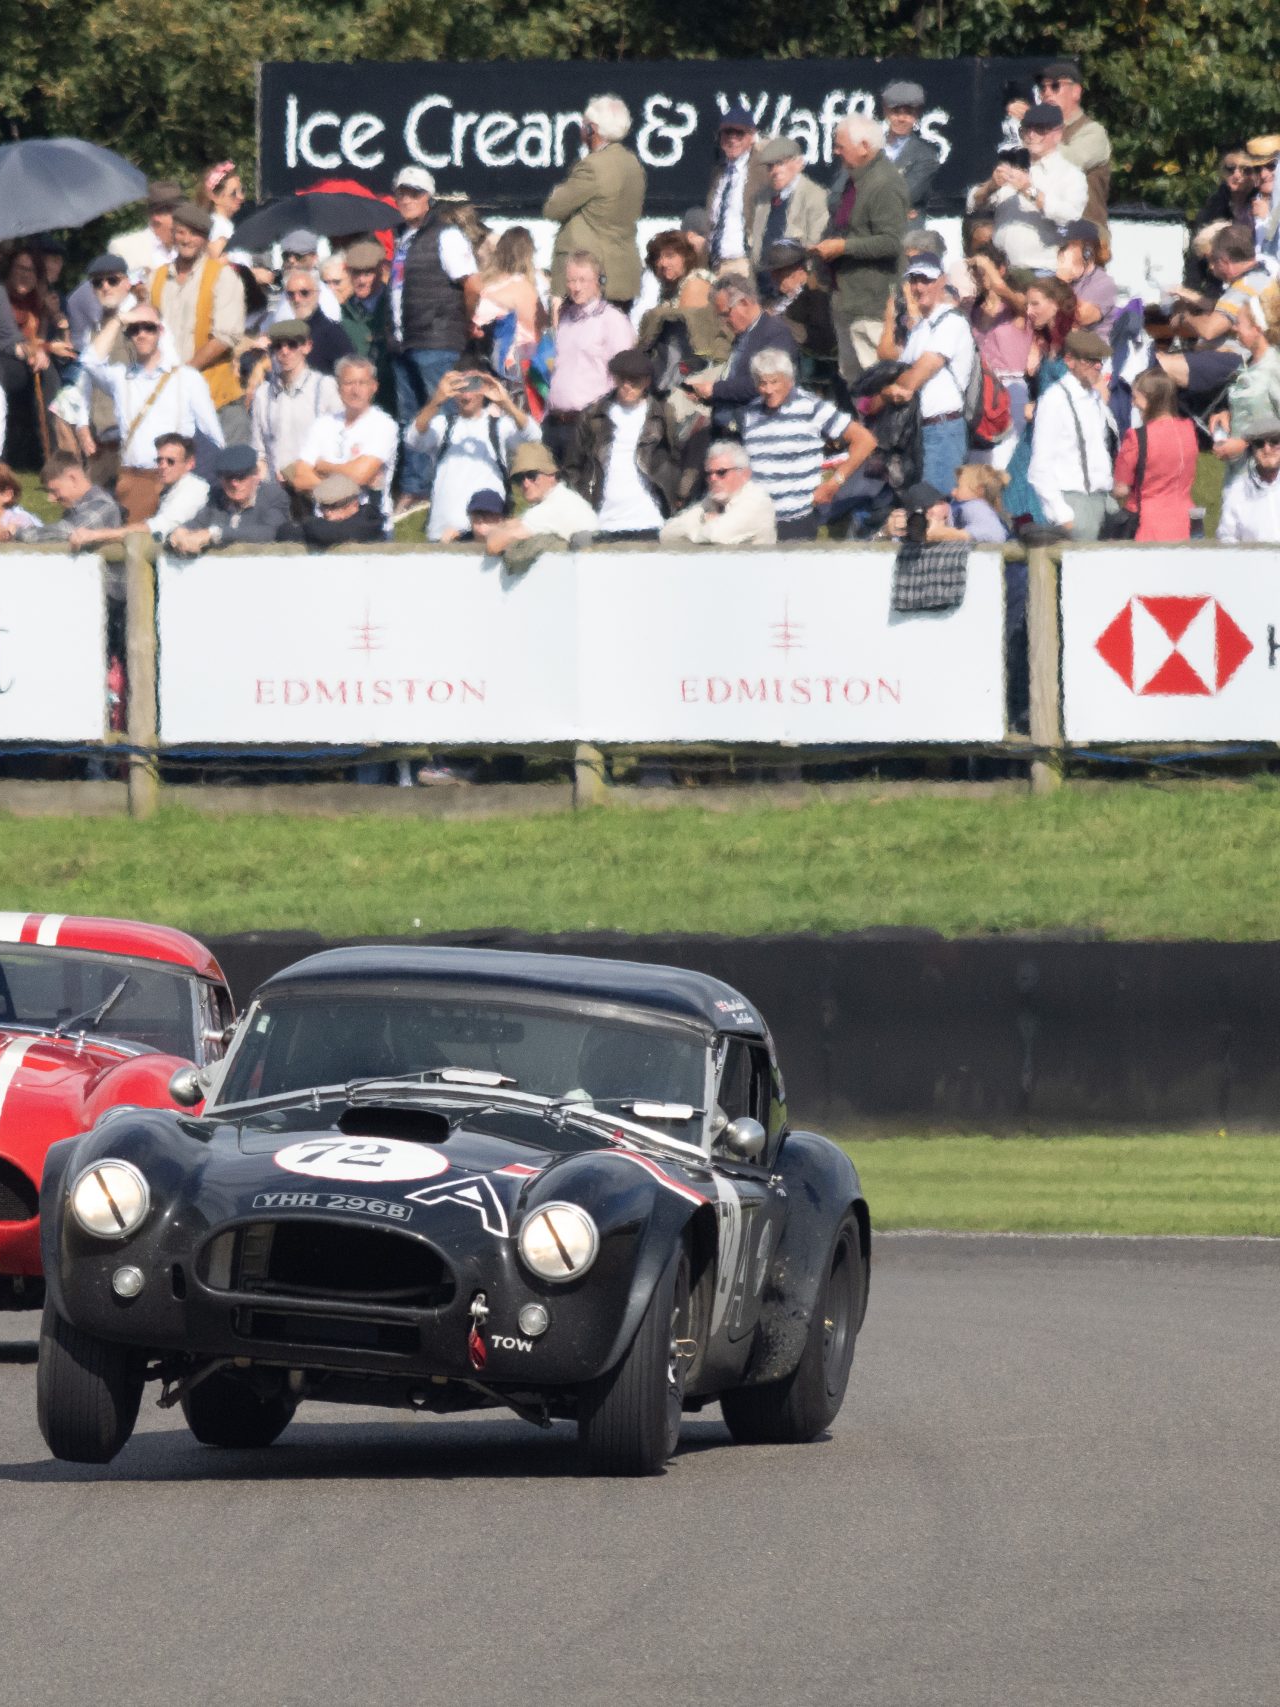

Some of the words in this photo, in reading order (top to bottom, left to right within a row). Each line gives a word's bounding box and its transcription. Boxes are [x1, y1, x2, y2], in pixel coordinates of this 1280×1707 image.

[286, 93, 385, 169] Ice
[636, 93, 697, 167] &
[254, 678, 487, 705] EDMISTON
[681, 676, 902, 705] EDMISTON
[296, 1142, 392, 1167] 72
[263, 1194, 319, 1207] YHH
[326, 1196, 406, 1219] 296B
[491, 1335, 533, 1352] TOW
